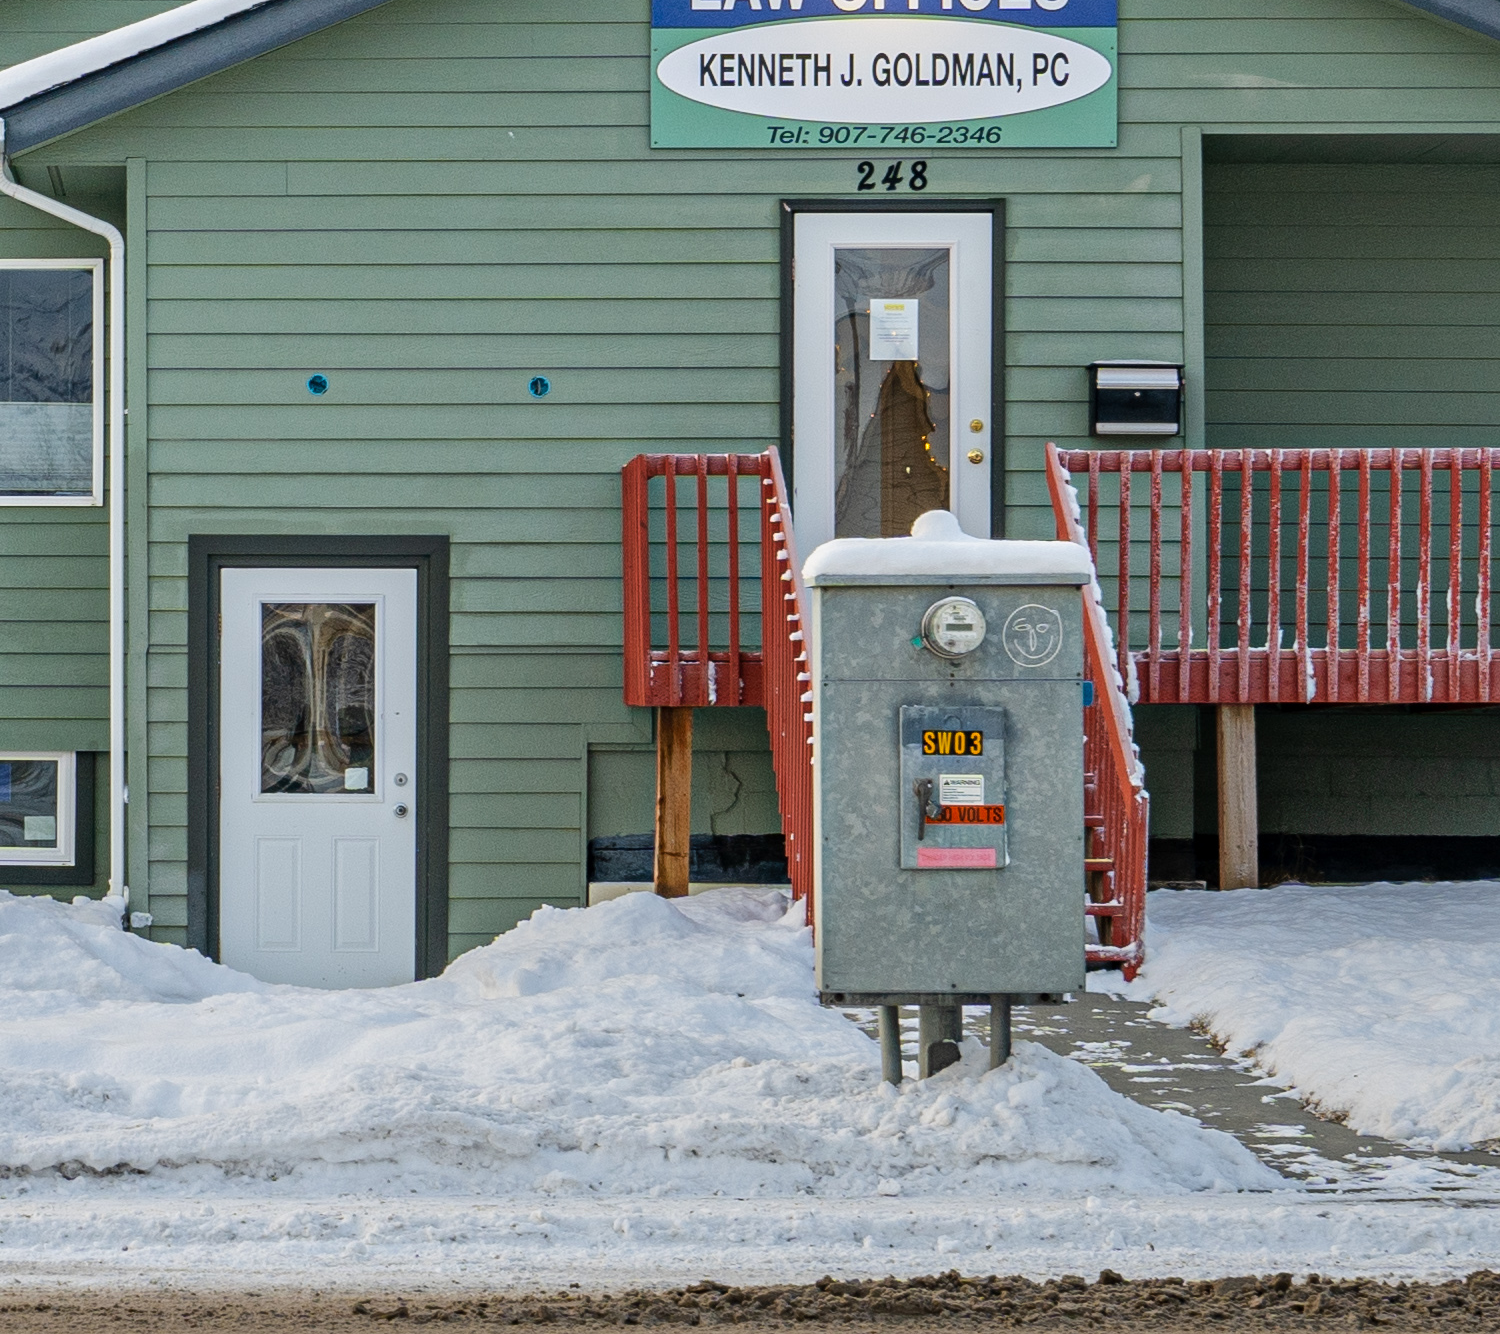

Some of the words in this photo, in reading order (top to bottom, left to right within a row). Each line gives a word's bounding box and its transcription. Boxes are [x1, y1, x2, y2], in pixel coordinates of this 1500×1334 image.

[699, 53, 831, 87] KENNETH
[840, 53, 862, 87] J.
[872, 53, 1022, 93] GOLDMAN,
[1032, 53, 1070, 87] PC
[767, 126, 810, 144] Tel:
[818, 126, 1003, 144] 907-746-2346
[856, 160, 929, 192] 248
[957, 806, 1003, 823] VOLTS
